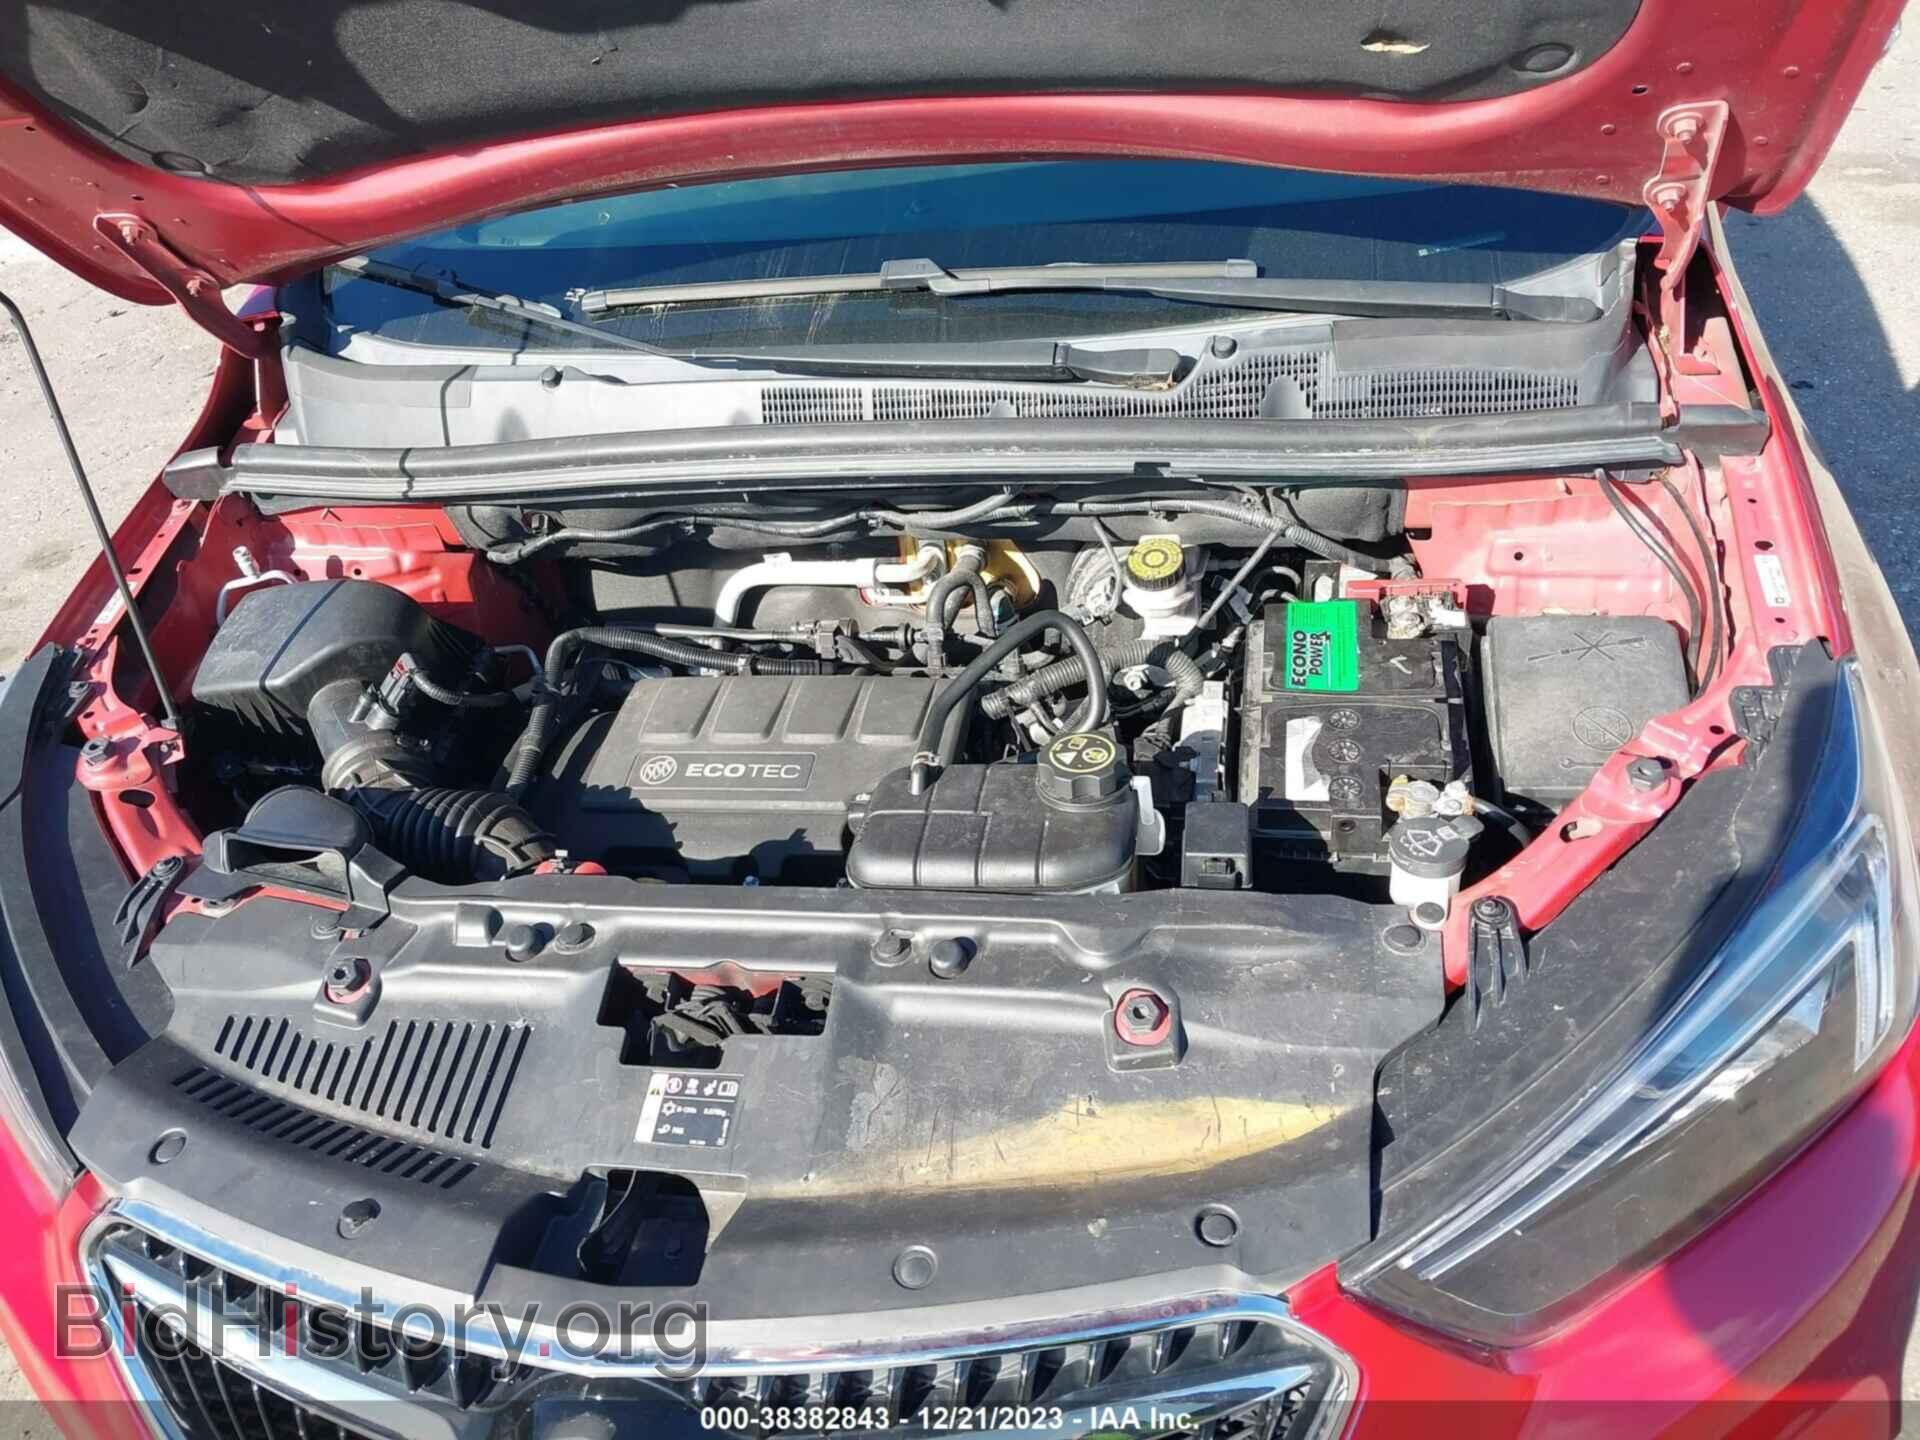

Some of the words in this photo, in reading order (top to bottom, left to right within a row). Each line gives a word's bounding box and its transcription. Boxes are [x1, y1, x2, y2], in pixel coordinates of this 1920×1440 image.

[1291, 630, 1307, 687] ECONO
[1309, 632, 1327, 676] POWER
[685, 763, 801, 779] ECOTEC
